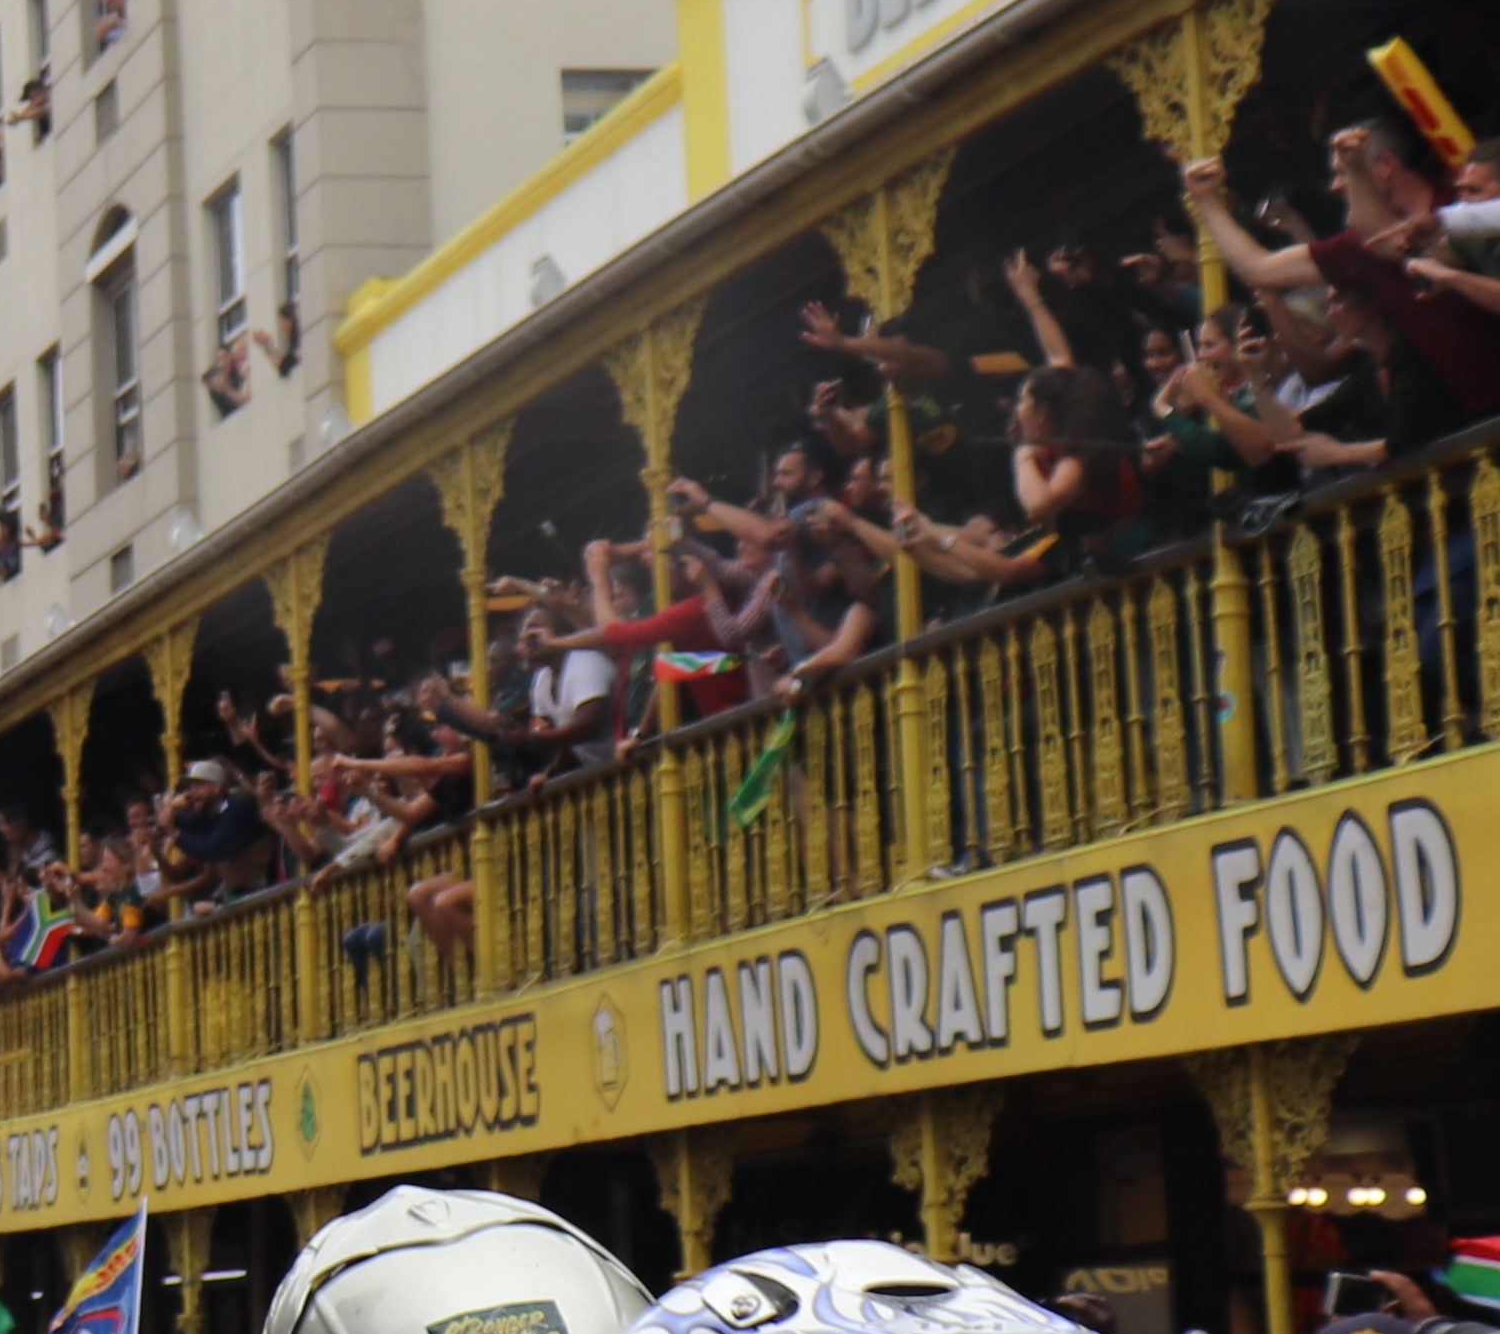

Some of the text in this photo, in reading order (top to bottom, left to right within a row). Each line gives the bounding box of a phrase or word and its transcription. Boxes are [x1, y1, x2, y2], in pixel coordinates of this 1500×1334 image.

[7, 1126, 58, 1210] TAPS
[108, 1108, 142, 1201] 99
[149, 1078, 274, 1190] BOTTLES
[358, 1012, 539, 1156] BEERHOUSE
[659, 948, 818, 1100] HAND
[845, 863, 1176, 1069] CRAFTED
[1211, 796, 1461, 1007] FOOD
